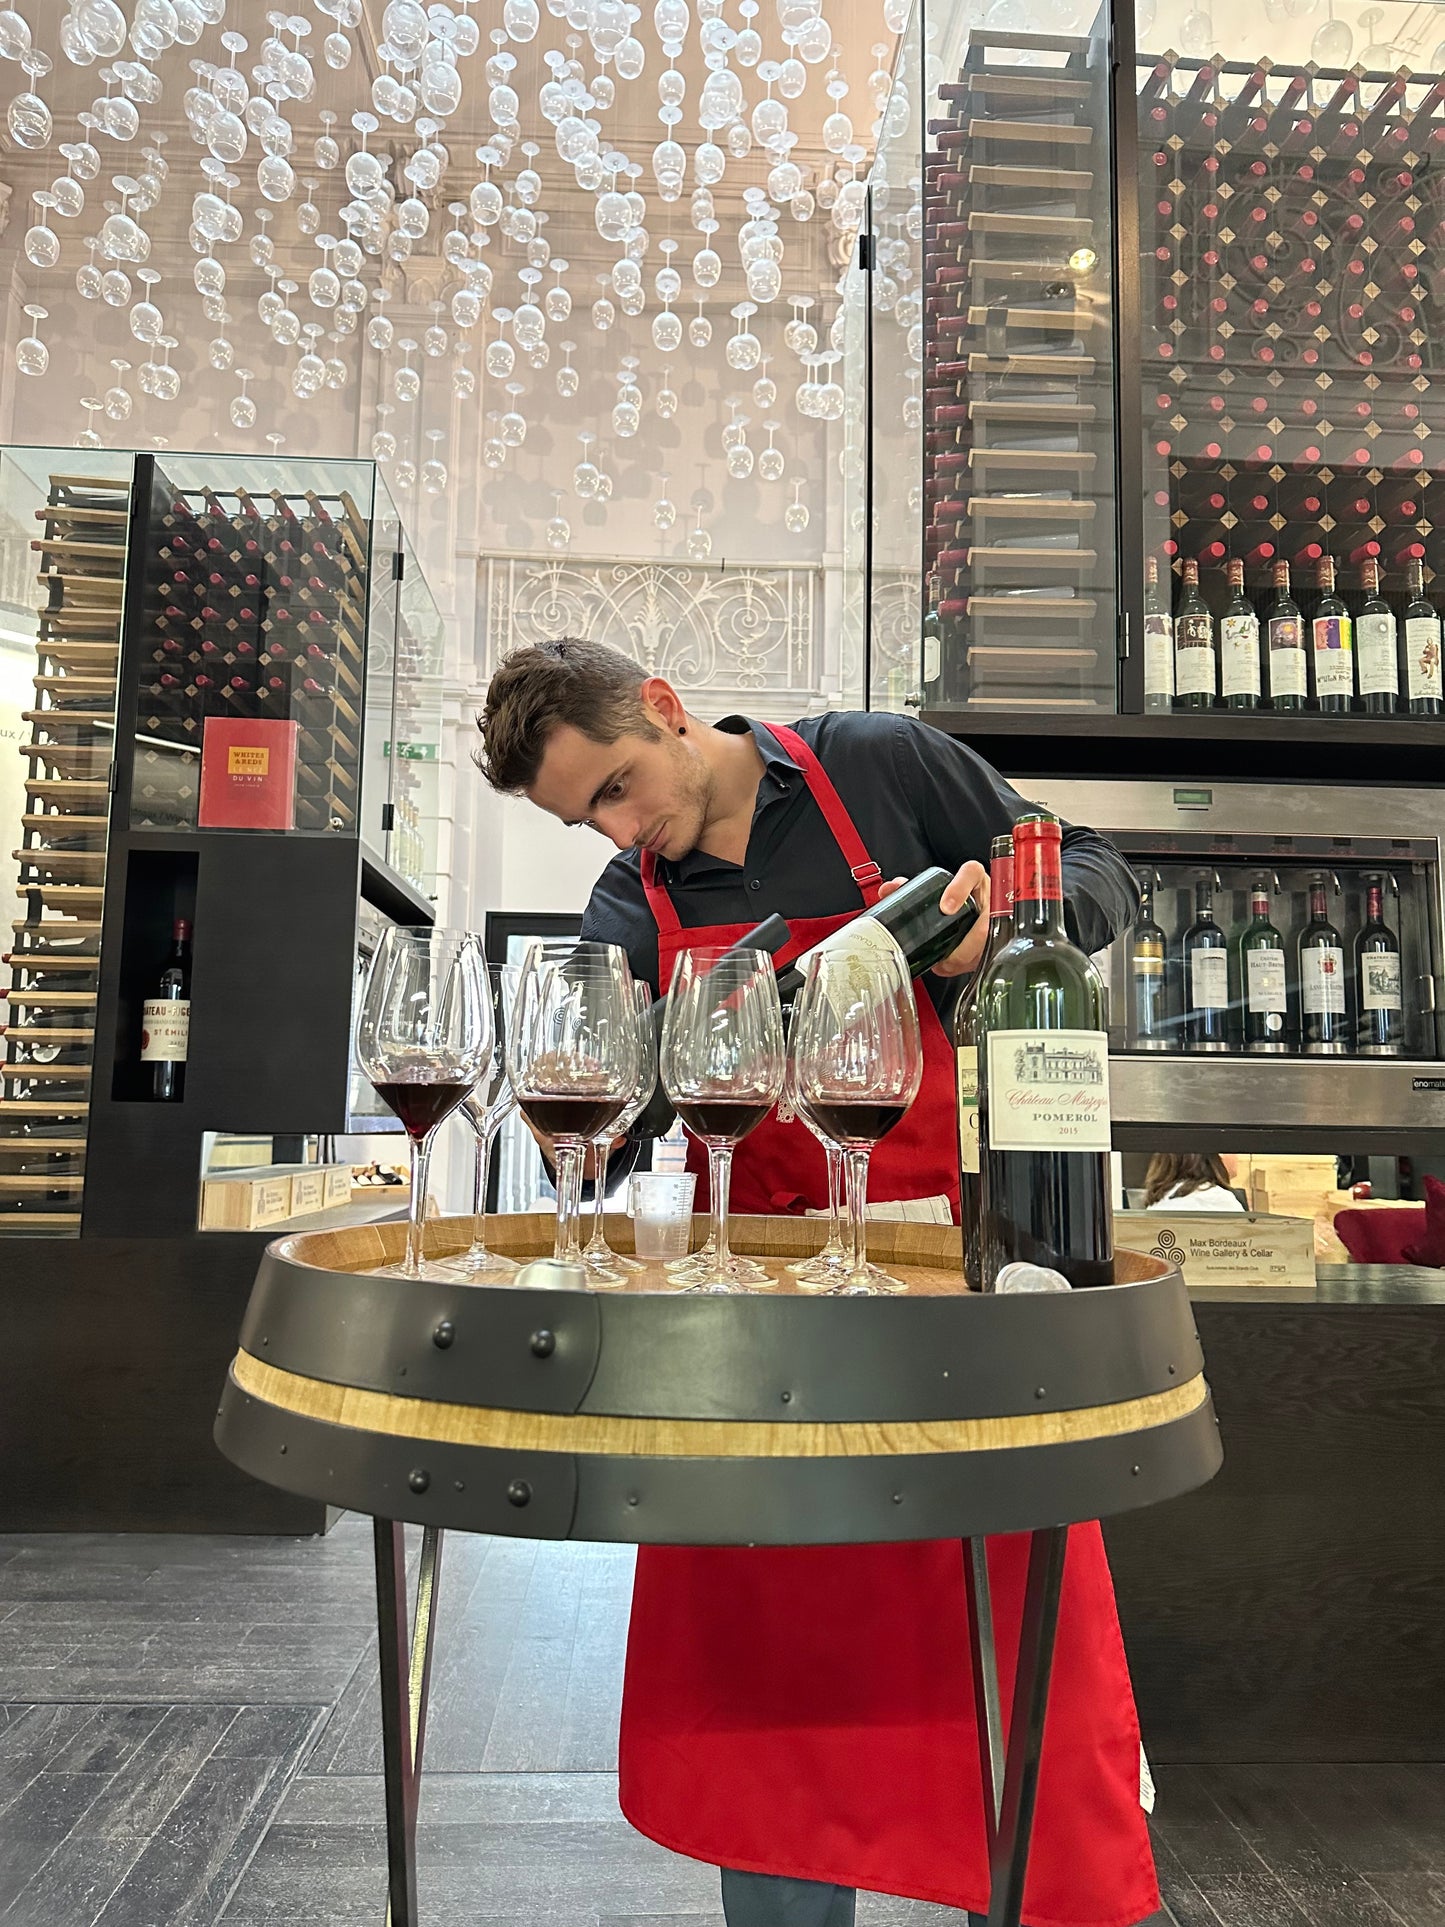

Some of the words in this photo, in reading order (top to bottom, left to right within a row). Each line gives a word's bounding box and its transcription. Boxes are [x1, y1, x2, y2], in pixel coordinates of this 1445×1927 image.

[1005, 1088, 1055, 1110] Château
[1032, 1113, 1098, 1122] POMEROL
[1059, 1126, 1079, 1135] 2015
[1189, 1239, 1207, 1247] Max
[1209, 1239, 1247, 1247] Bordeaux
[1190, 1248, 1211, 1257] Wine
[1212, 1248, 1240, 1260] Gallery
[1241, 1248, 1248, 1257] &
[1250, 1249, 1273, 1258] Cellar
